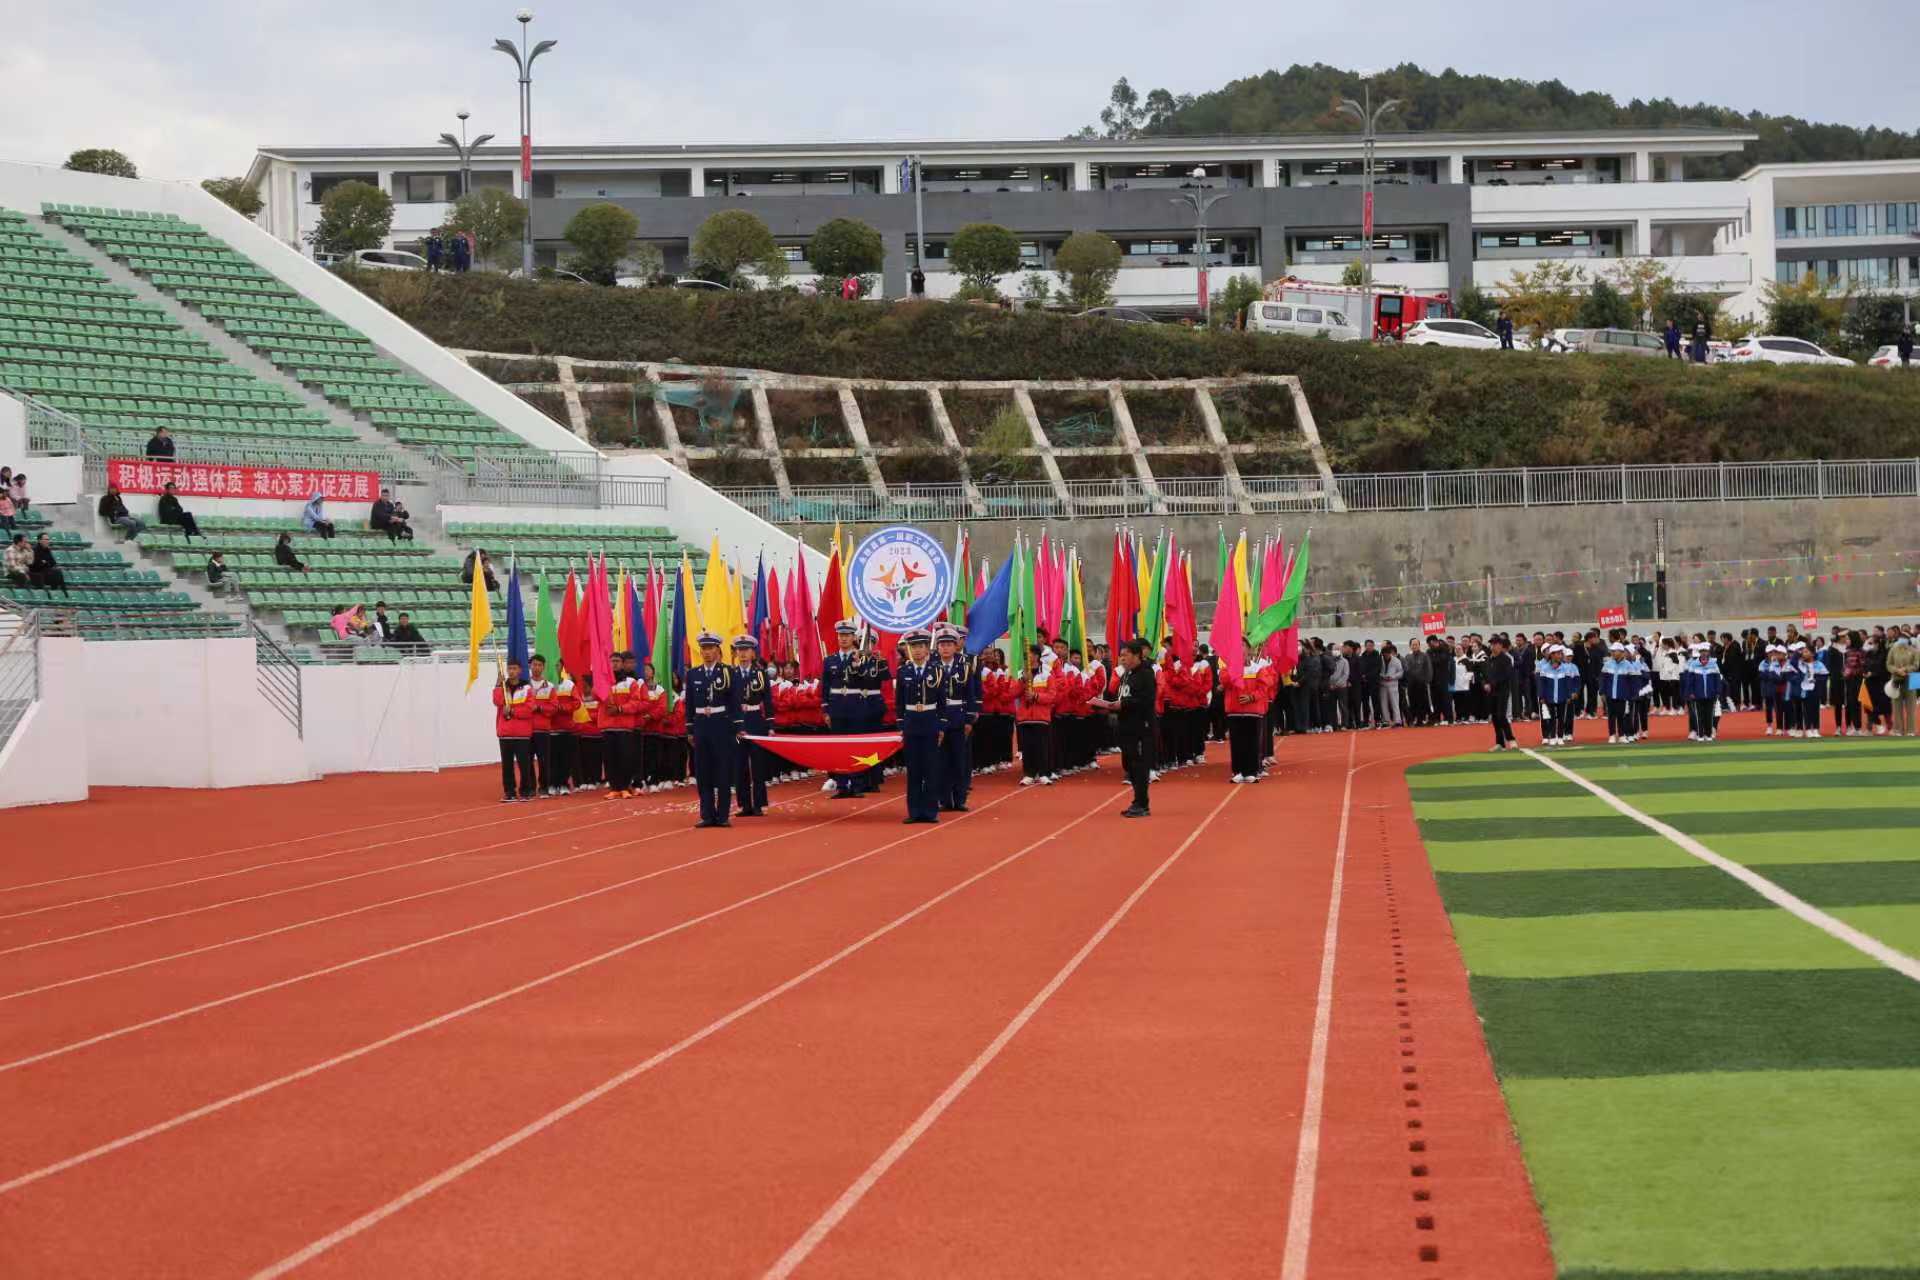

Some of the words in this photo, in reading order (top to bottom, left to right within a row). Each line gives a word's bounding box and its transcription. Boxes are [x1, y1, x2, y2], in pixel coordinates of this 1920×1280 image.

[118, 463, 243, 494] 积极运动强体质
[253, 470, 369, 498] 凝心聚力促发展
